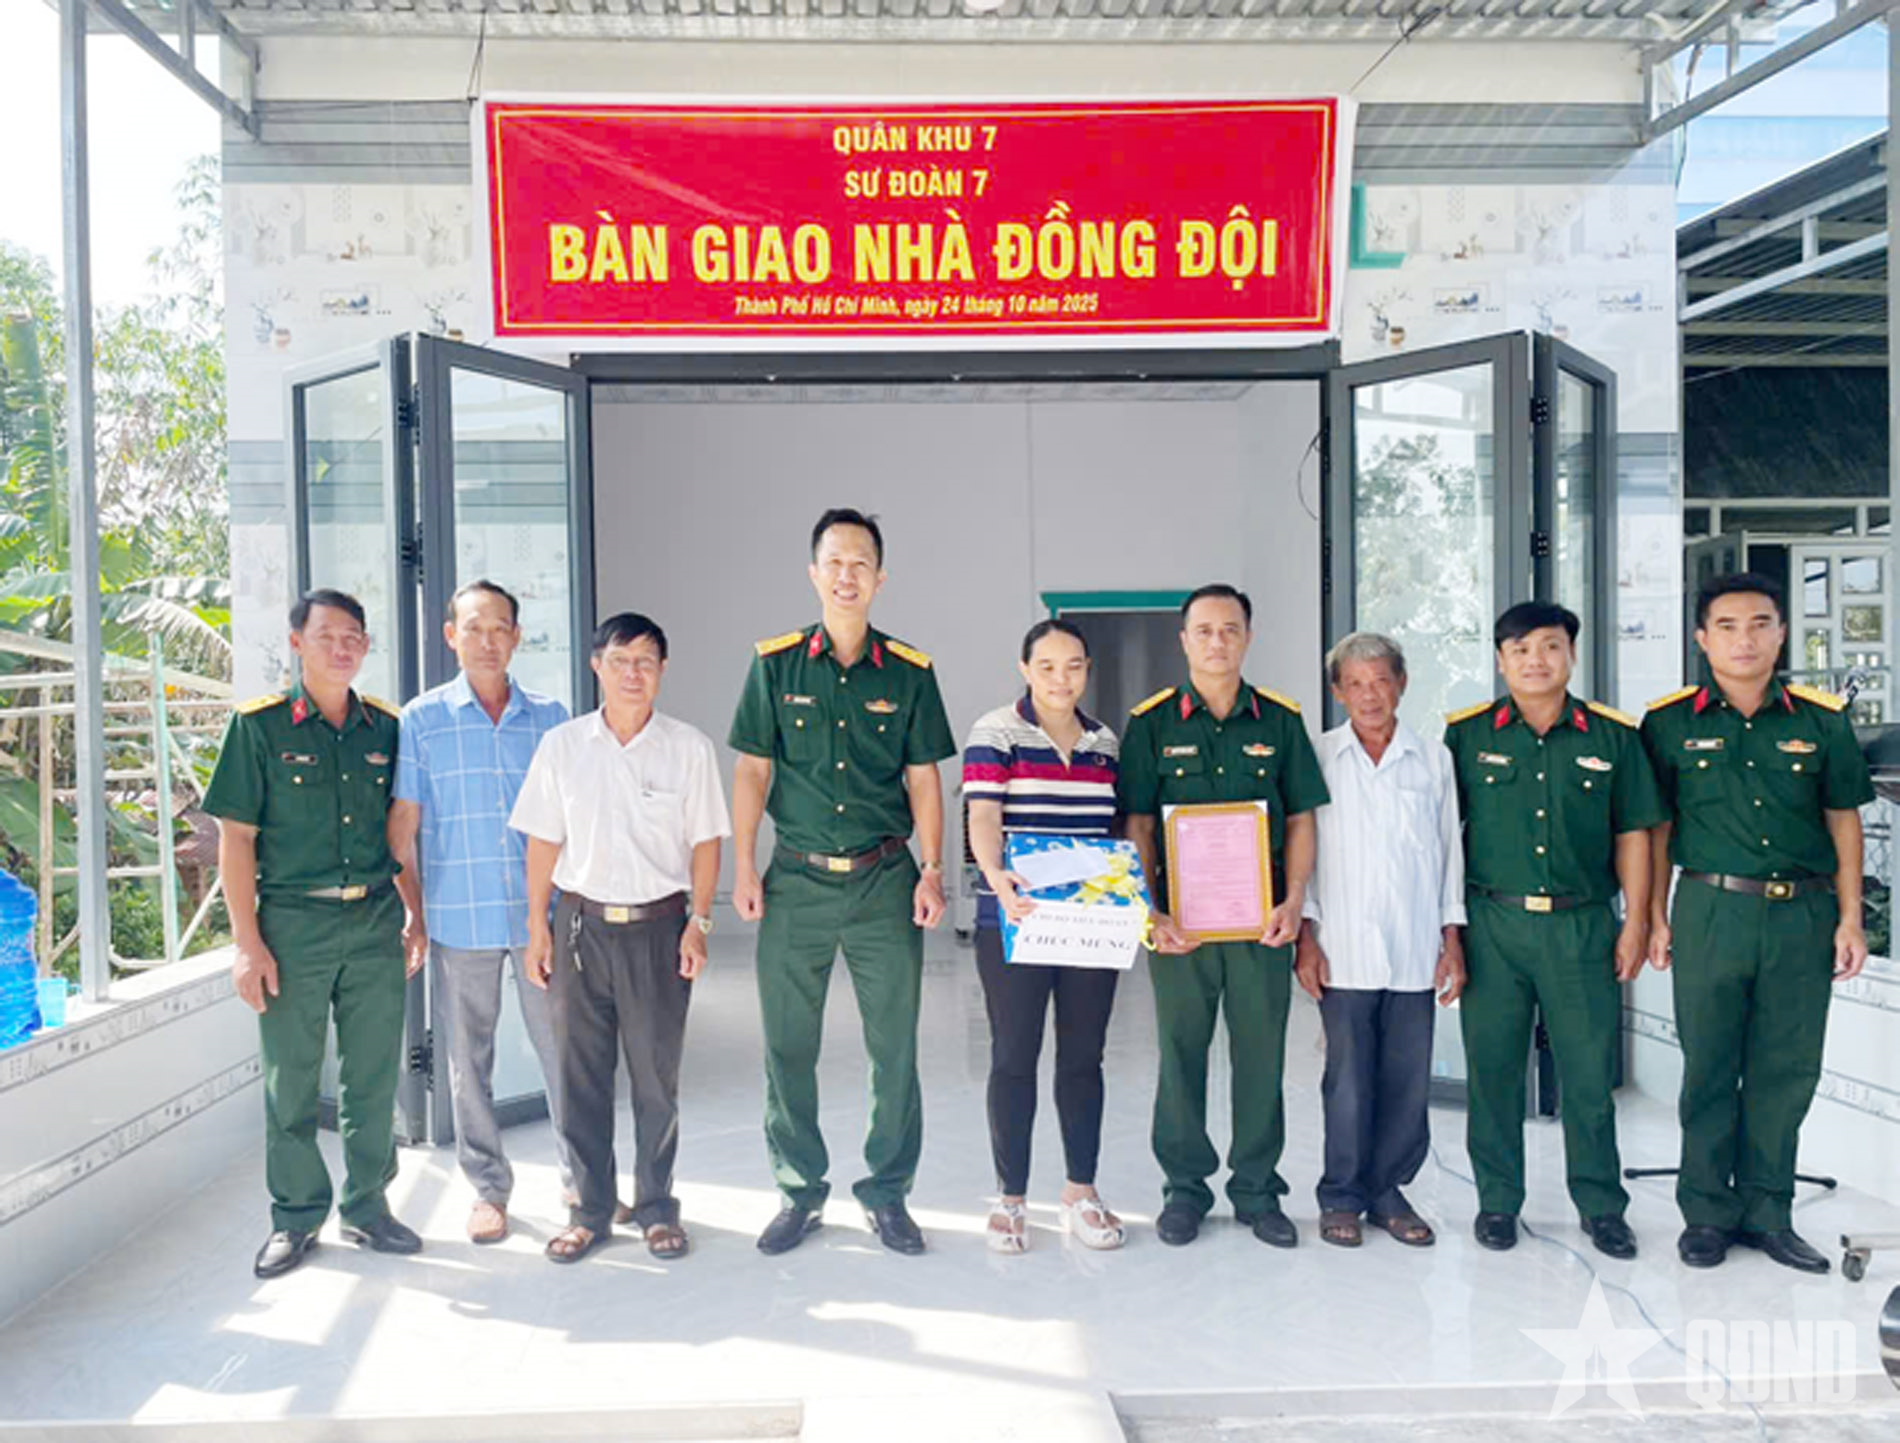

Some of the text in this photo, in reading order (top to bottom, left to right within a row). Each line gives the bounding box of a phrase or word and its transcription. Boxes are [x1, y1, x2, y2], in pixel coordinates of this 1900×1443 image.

[833, 121, 998, 155] QUÂN KHU 7
[844, 164, 989, 197] SƯ ĐOÀN 7
[549, 201, 1278, 291] BÀN GIAO NHÀ ĐỒNG ĐỘI
[735, 295, 778, 315] Thành
[781, 293, 810, 315] Phố
[834, 295, 860, 315] Chí
[861, 295, 900, 317] Minh,
[904, 296, 938, 318] ngày
[940, 295, 961, 314] 24
[964, 294, 1004, 317] tháng
[1009, 294, 1028, 314] 10
[1029, 294, 1059, 314] năm
[1062, 292, 1099, 314] 2025
